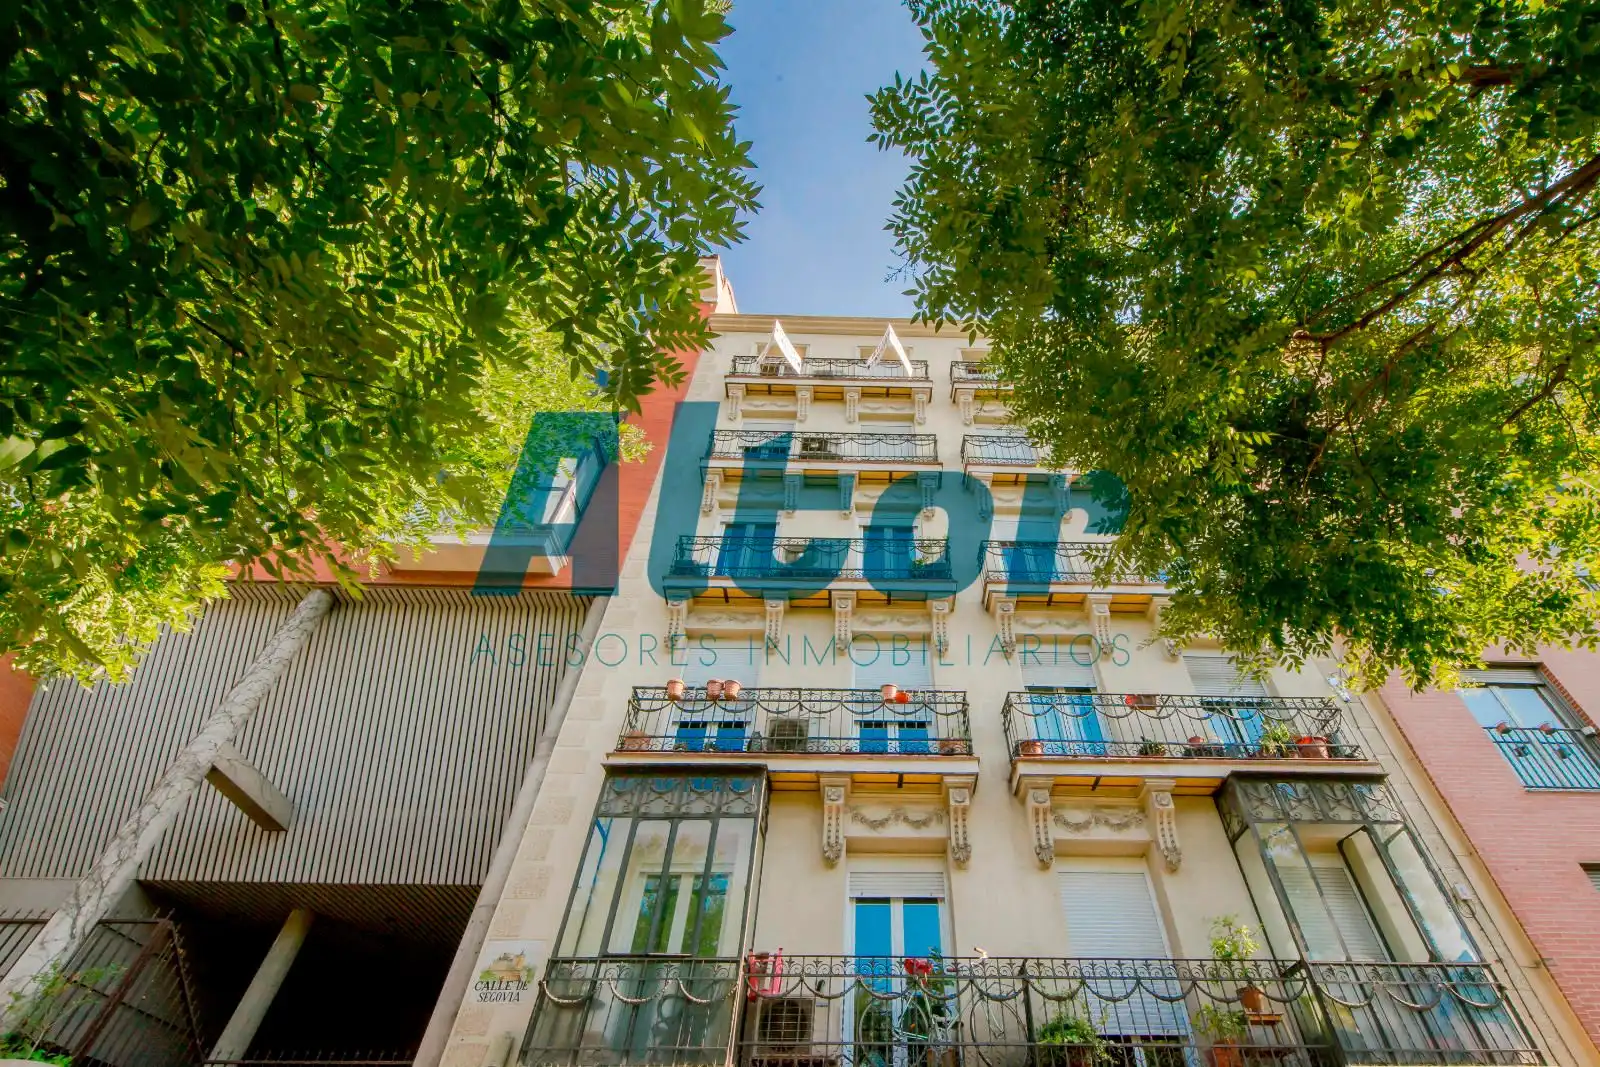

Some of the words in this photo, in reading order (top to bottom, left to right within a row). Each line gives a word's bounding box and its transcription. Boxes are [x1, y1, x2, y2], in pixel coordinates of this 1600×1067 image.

[474, 980, 513, 991] CALLE
[516, 979, 529, 991] DE
[477, 991, 521, 1003] SEGOVIA
